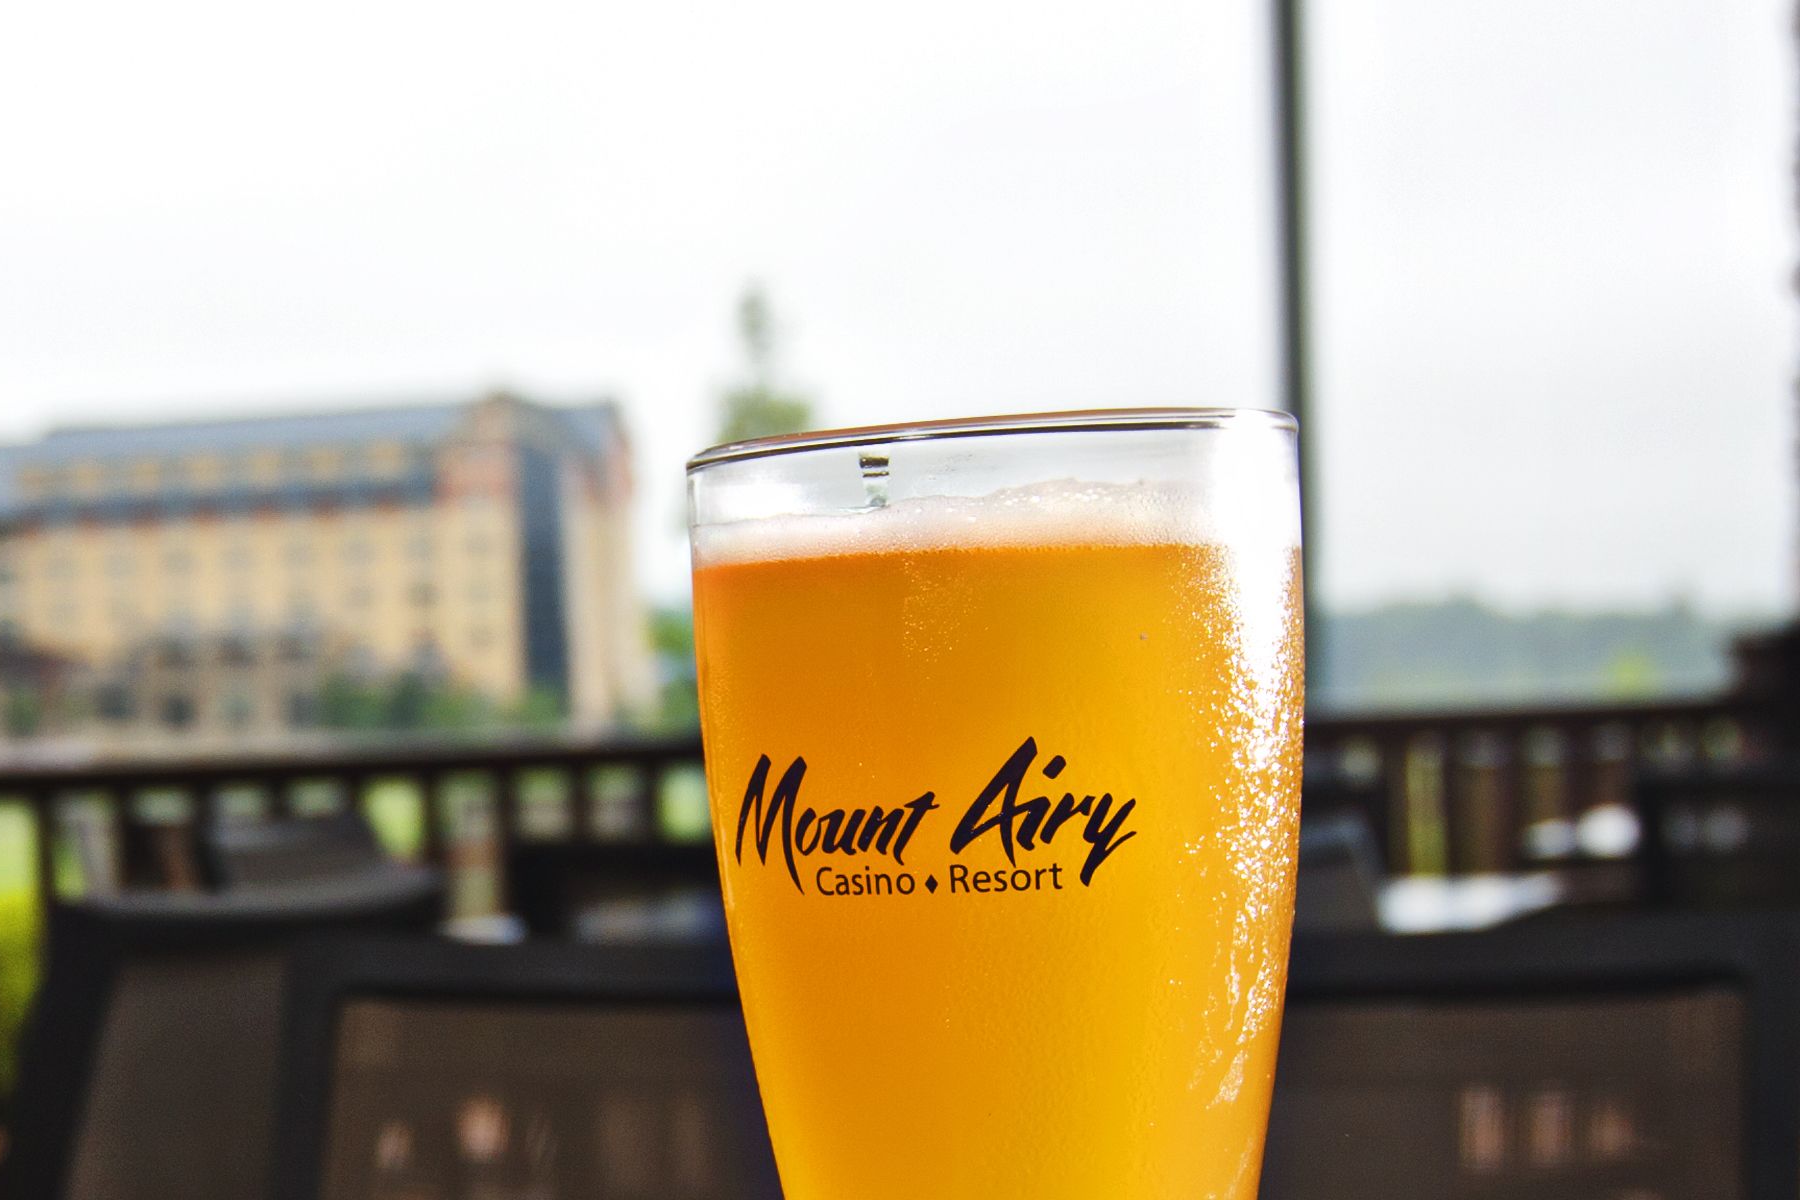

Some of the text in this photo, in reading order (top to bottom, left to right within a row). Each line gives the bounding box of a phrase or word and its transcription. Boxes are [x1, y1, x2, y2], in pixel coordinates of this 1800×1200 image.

[735, 736, 1137, 895] Mount Airy
[816, 862, 1064, 897] Casino Resort
